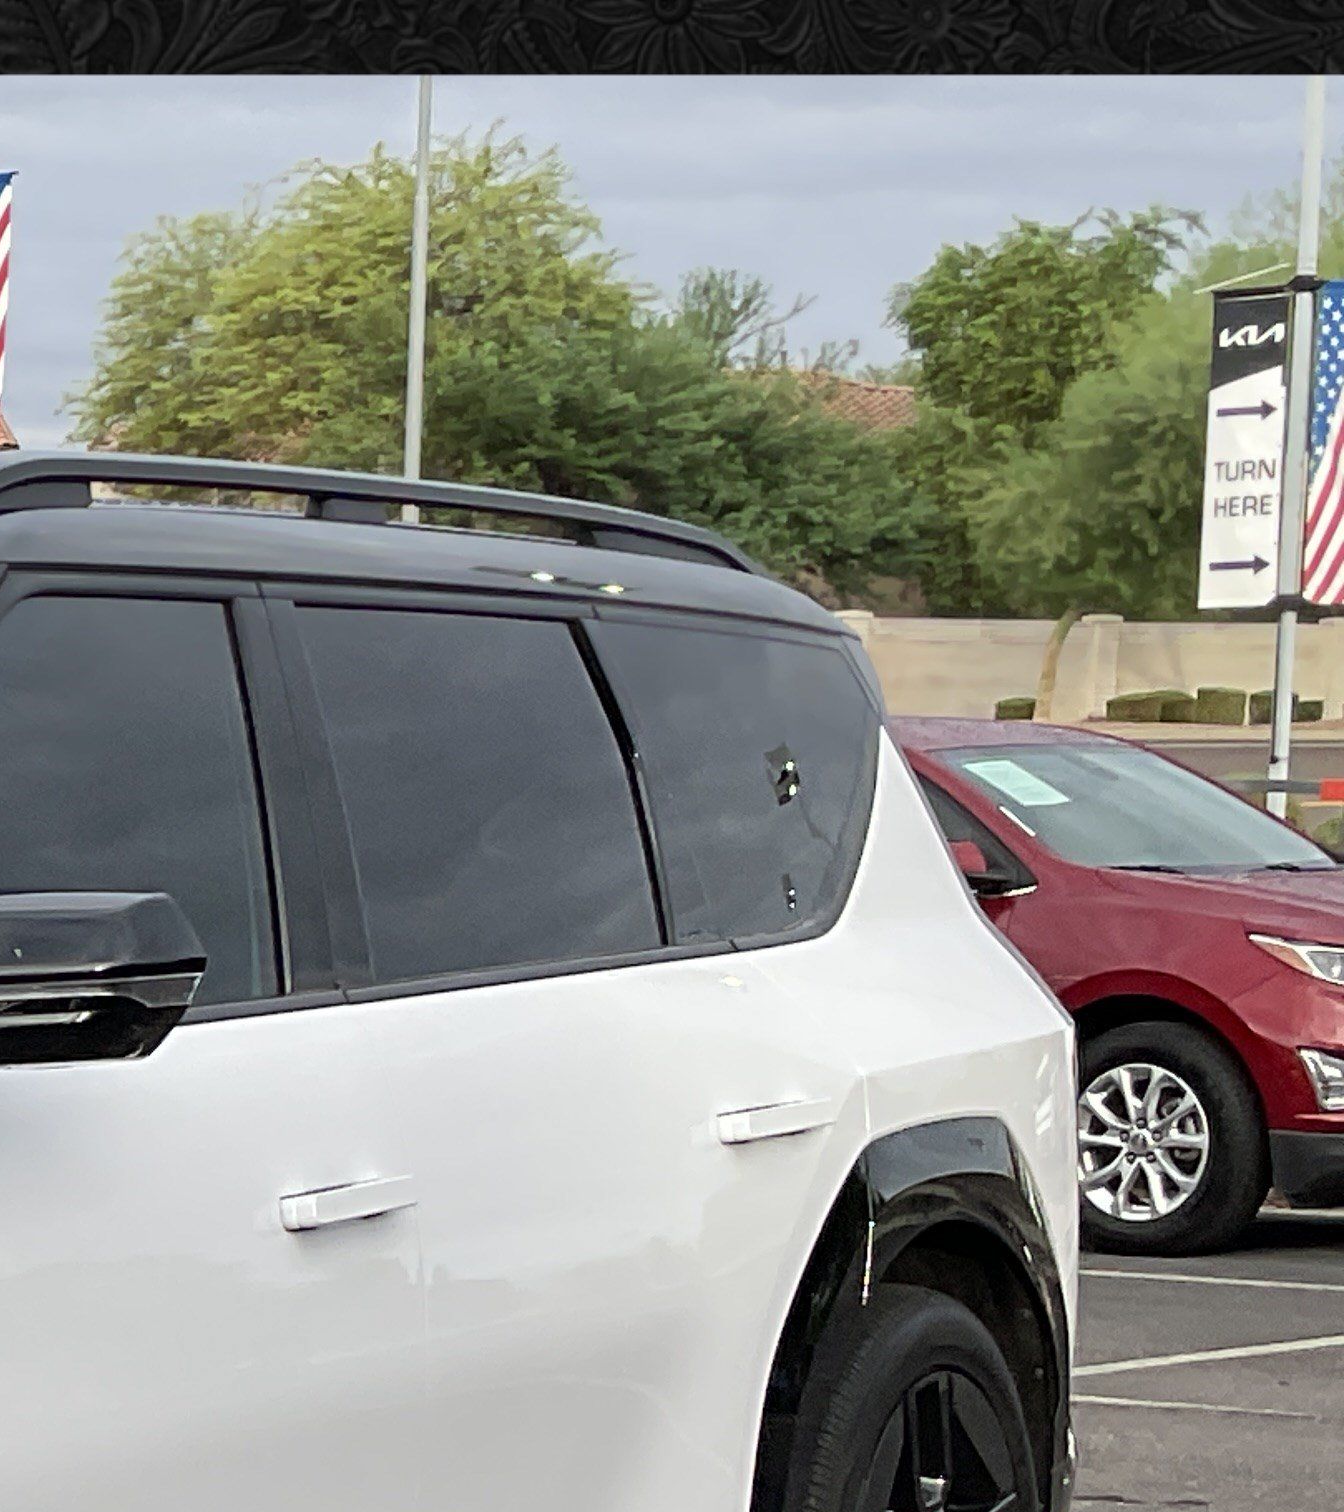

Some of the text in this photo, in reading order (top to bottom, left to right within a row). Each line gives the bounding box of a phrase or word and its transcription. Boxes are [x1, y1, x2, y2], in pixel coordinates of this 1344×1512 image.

[1219, 323, 1285, 348] KIA
[1214, 459, 1276, 482] TURN
[1214, 495, 1272, 518] HERE
